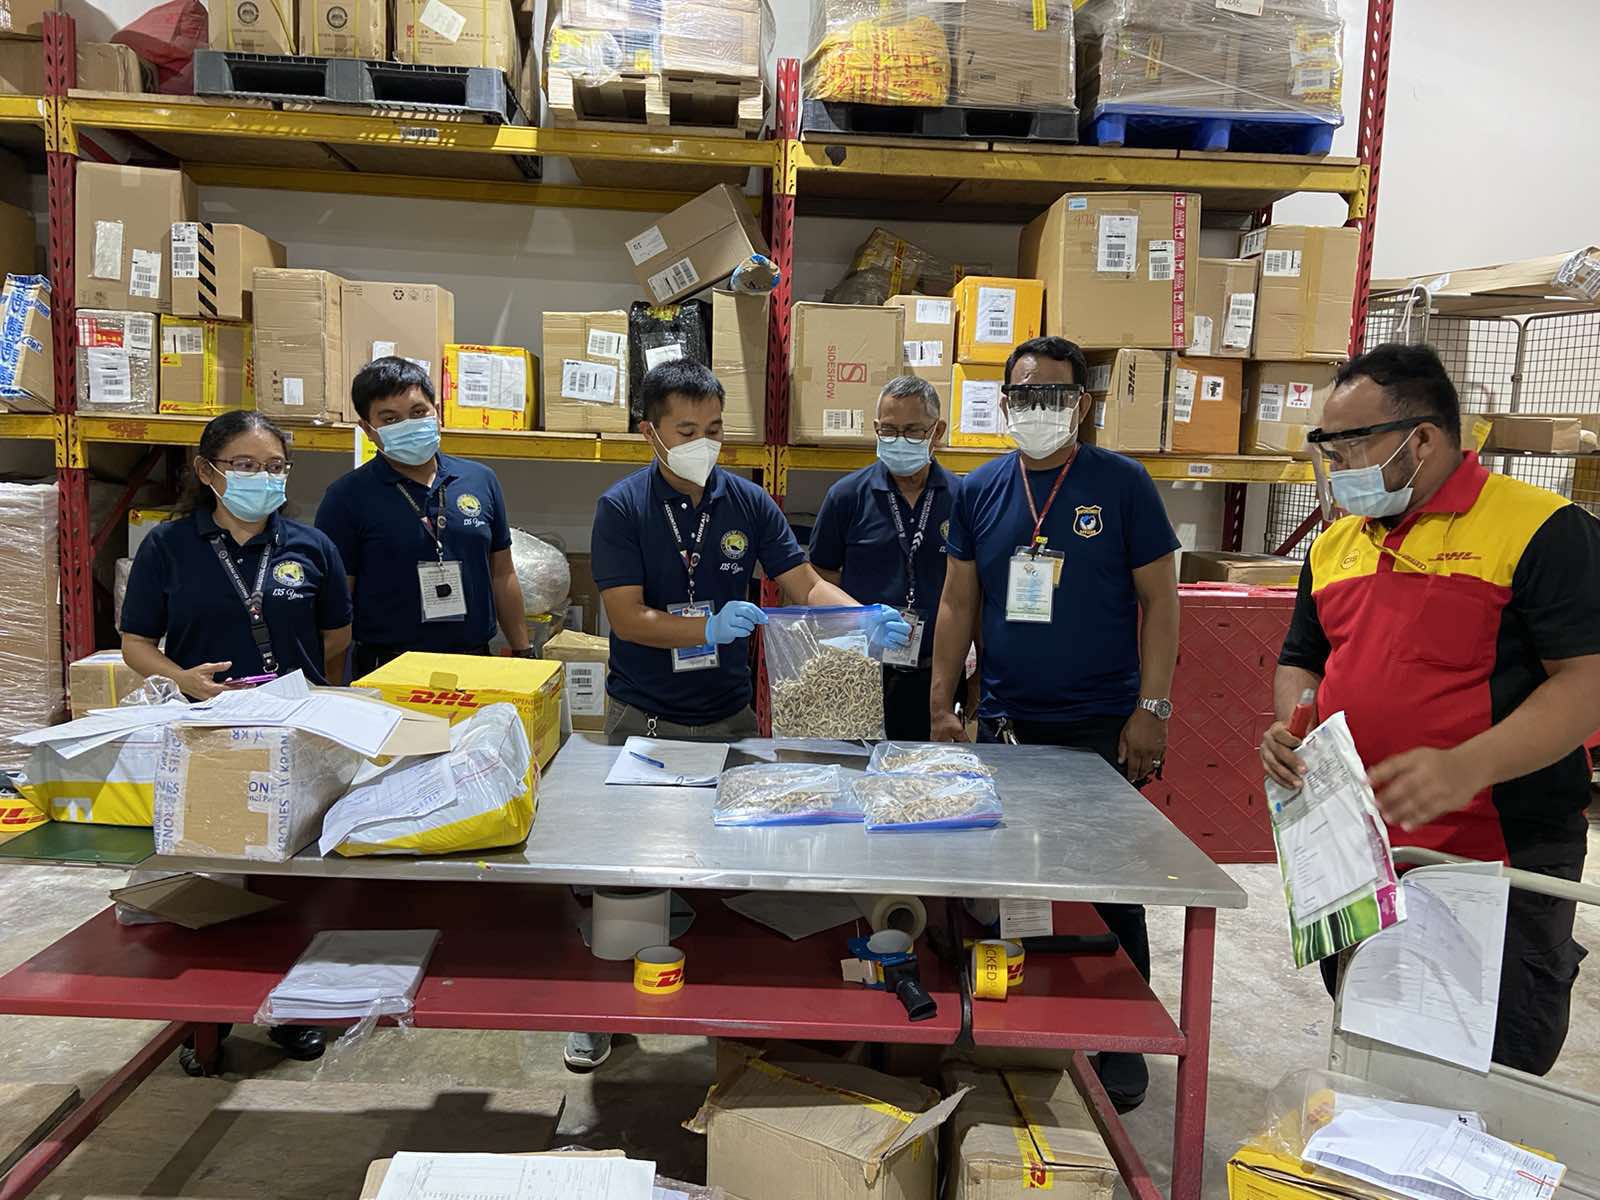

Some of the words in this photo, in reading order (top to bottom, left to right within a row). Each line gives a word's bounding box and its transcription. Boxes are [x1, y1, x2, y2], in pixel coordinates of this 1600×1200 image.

[826, 345, 837, 400] SIDESHOW
[1127, 361, 1137, 399] DHL
[664, 503, 682, 544] ACCOUNTABILITY
[696, 512, 707, 543] BUREAU
[409, 689, 481, 709] DHL
